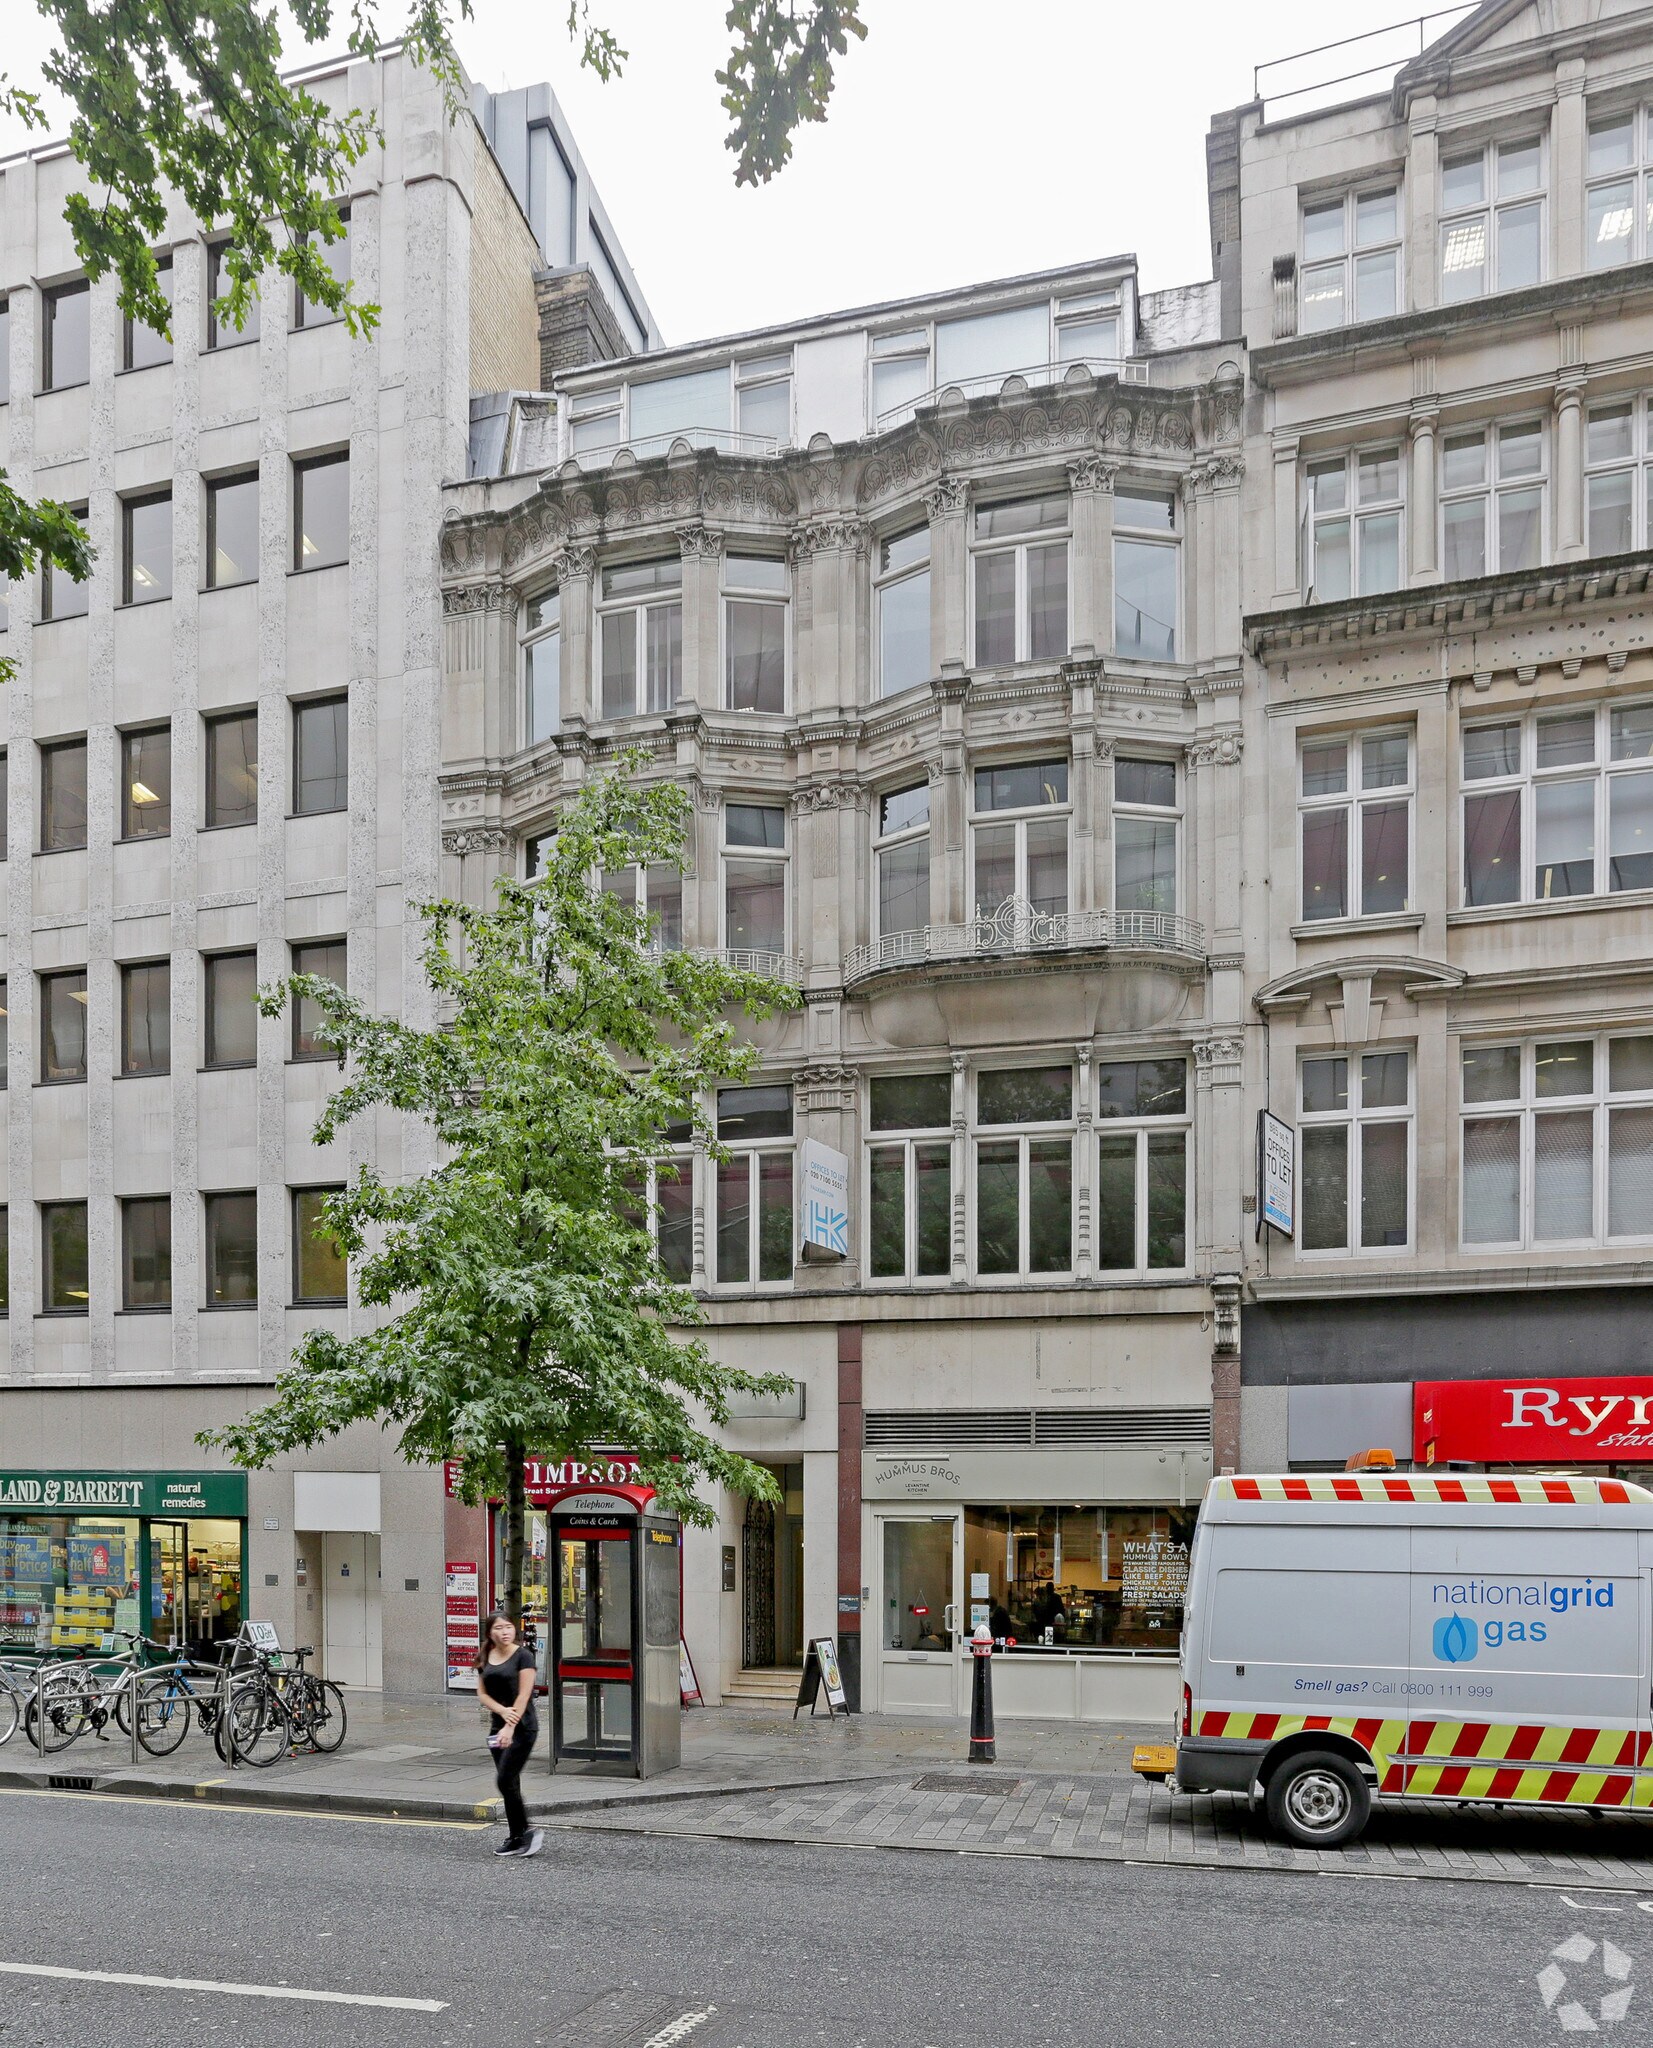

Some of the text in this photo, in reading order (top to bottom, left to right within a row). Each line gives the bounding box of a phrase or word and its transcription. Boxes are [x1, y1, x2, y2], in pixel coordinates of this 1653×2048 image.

[1268, 1138, 1290, 1164] OFFICES
[810, 1161, 829, 1176] OFFICES
[830, 1169, 838, 1179] TO
[810, 1170, 819, 1180] 020
[1266, 1153, 1291, 1186] TO LET
[875, 1461, 961, 1486] HUMMUS BROS.
[43, 1480, 61, 1507] &
[63, 1480, 144, 1508] BARRETT
[167, 1482, 201, 1494] natural
[162, 1497, 206, 1508] remedies
[574, 1499, 616, 1510] Telephone
[569, 1516, 619, 1526] Coins & Cards
[651, 1530, 673, 1545] Telephone
[15, 1543, 31, 1553] one
[71, 1541, 88, 1553] buy
[1123, 1542, 1188, 1553] WHAT'S A
[1122, 1553, 1189, 1561] HUMMUS BOWL?
[19, 1560, 48, 1573] price
[70, 1556, 92, 1572] half
[1484, 1620, 1547, 1648] gas
[1294, 1679, 1494, 1698] Smell gas? Call 0800 111 999
